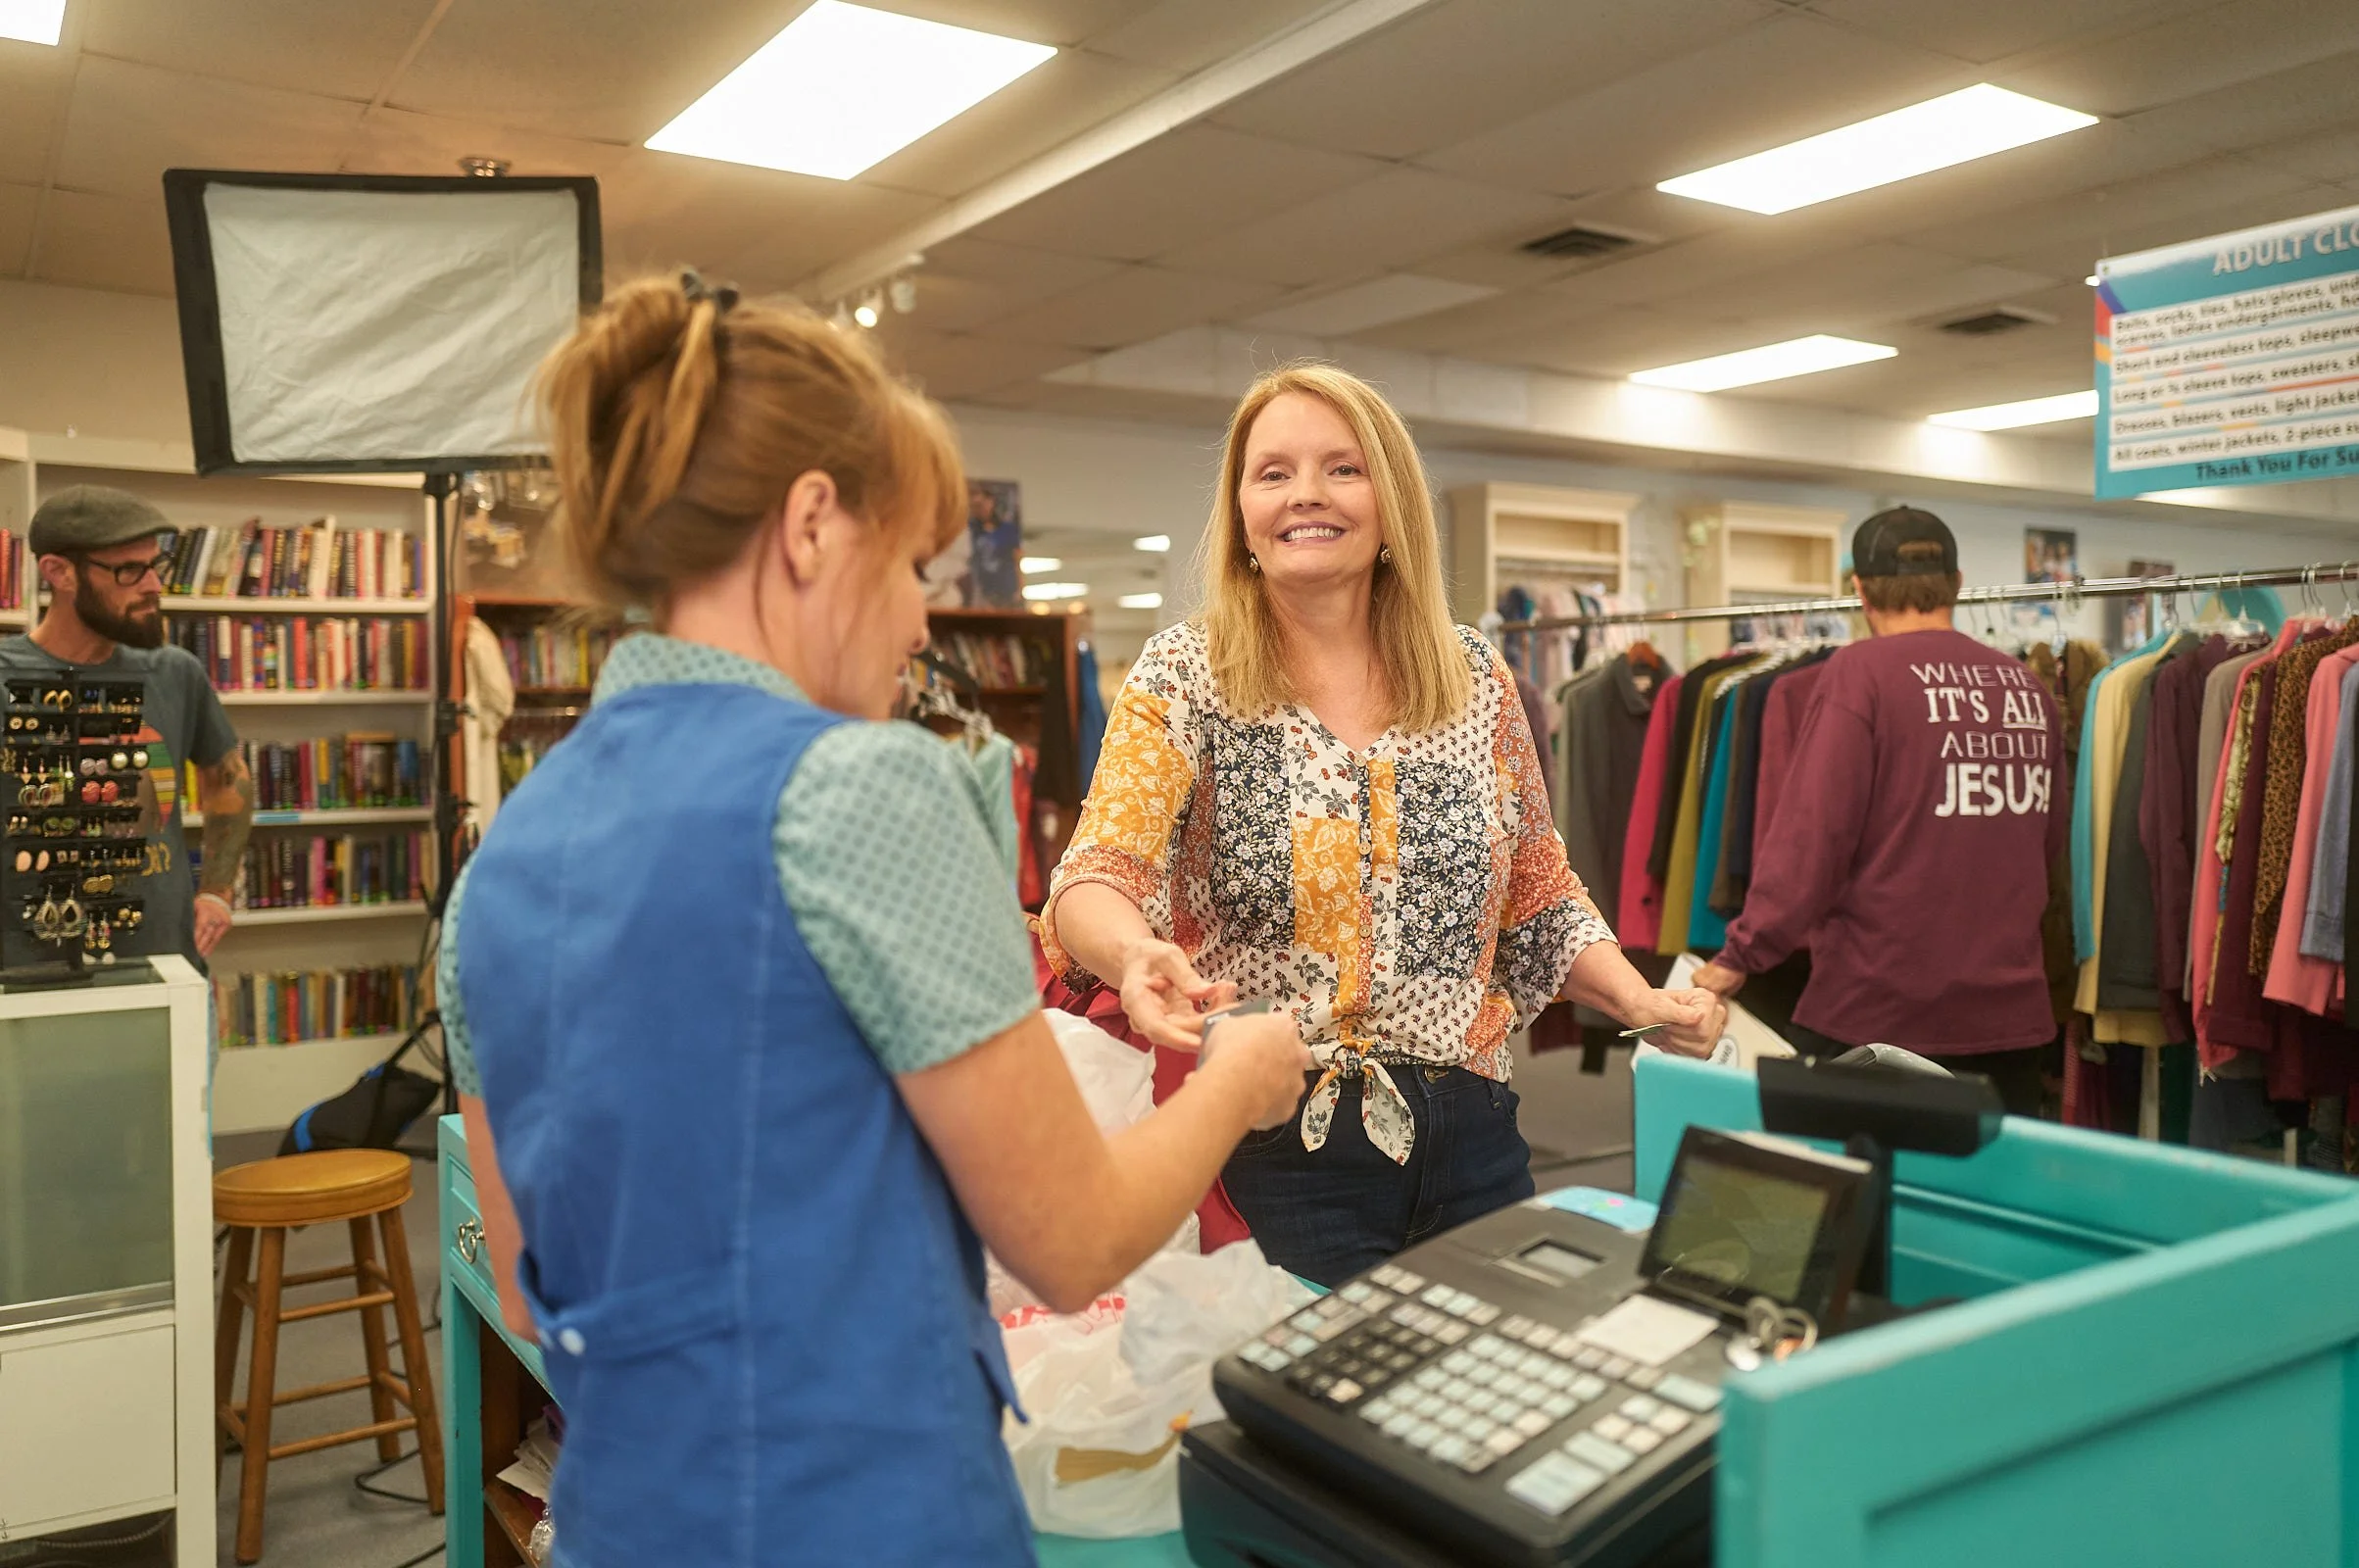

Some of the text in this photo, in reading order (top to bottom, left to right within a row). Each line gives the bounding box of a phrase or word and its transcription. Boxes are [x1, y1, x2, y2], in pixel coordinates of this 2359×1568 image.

[2212, 234, 2304, 275] ADULT
[2154, 352, 2179, 366] and
[2275, 395, 2310, 416] light
[2196, 460, 2251, 480] Thank
[2257, 456, 2291, 473] You
[2297, 451, 2329, 470] For
[1909, 662, 2039, 690] WHERE
[1924, 687, 2047, 729] IT'S ALL
[1941, 731, 2047, 760] ABOUT
[1935, 762, 2051, 817] JESUS!
